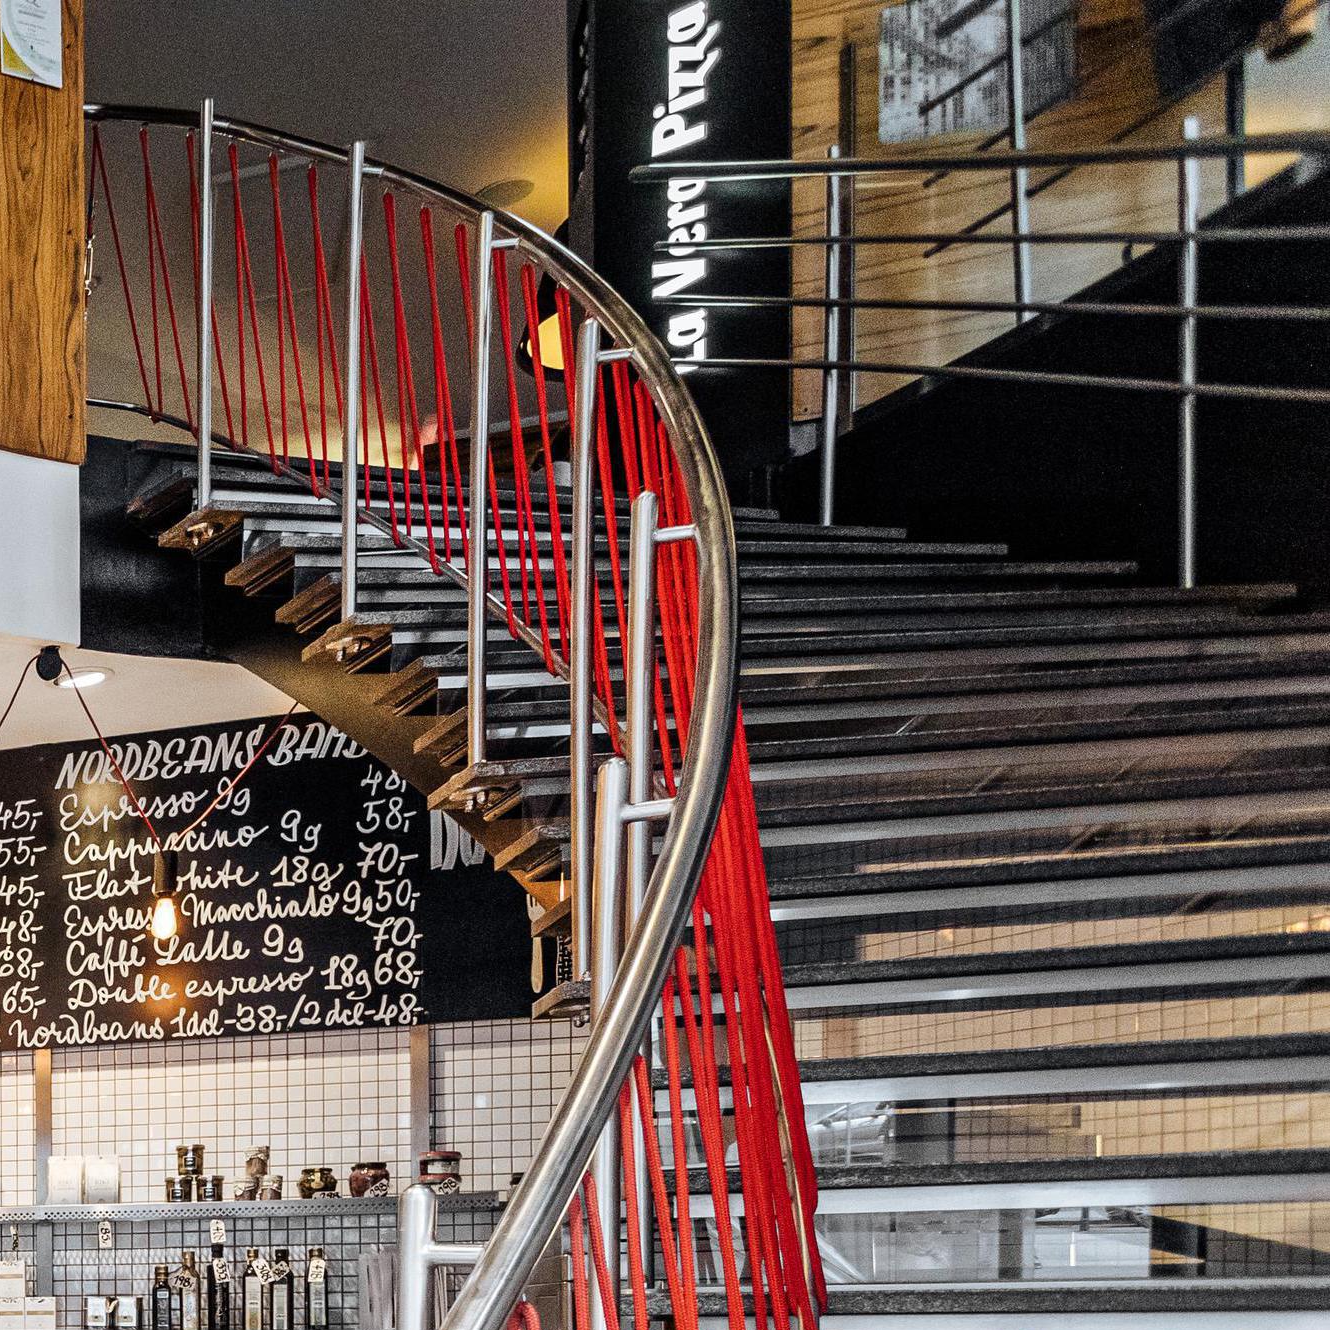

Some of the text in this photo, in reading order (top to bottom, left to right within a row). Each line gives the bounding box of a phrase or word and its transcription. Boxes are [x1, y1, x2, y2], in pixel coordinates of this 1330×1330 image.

[651, 1, 721, 158] Pizza
[651, 178, 707, 299] Nera
[55, 724, 266, 789] NORDBEANS
[59, 790, 208, 832] Espresso
[63, 822, 270, 869] Cappuccino
[62, 868, 152, 901] Flat
[153, 858, 259, 891] hite
[270, 856, 344, 892] 18g
[63, 904, 155, 940] Espress
[181, 884, 340, 928] Macchiato
[66, 936, 146, 986] Caffé
[154, 929, 251, 966] Latte
[68, 974, 178, 1010] Double
[185, 965, 314, 1006] espresso
[321, 953, 372, 1000] 18g
